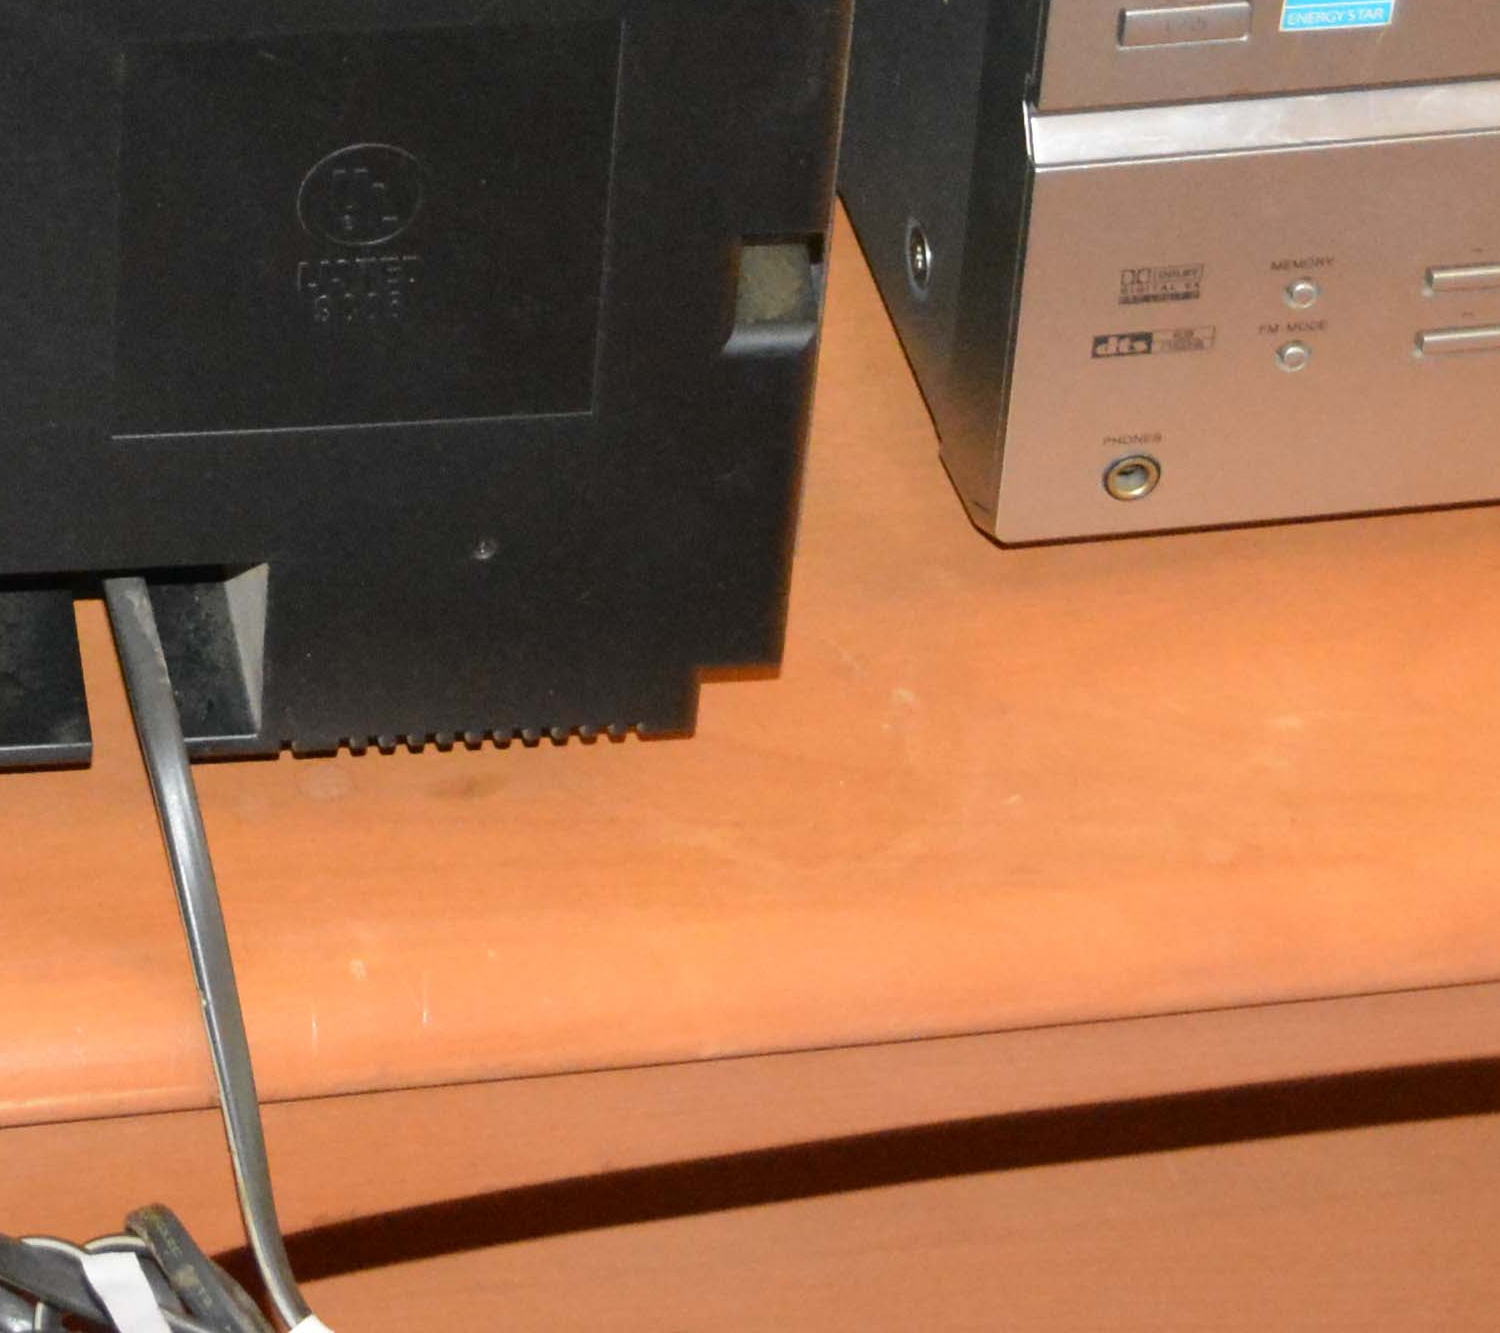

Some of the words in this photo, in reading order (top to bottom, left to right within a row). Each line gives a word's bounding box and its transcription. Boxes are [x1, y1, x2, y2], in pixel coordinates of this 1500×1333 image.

[1287, 10, 1346, 26] ENERGY
[1347, 7, 1385, 22] STAR
[1268, 255, 1336, 272] MEMORY
[1103, 431, 1163, 447] PHONES
